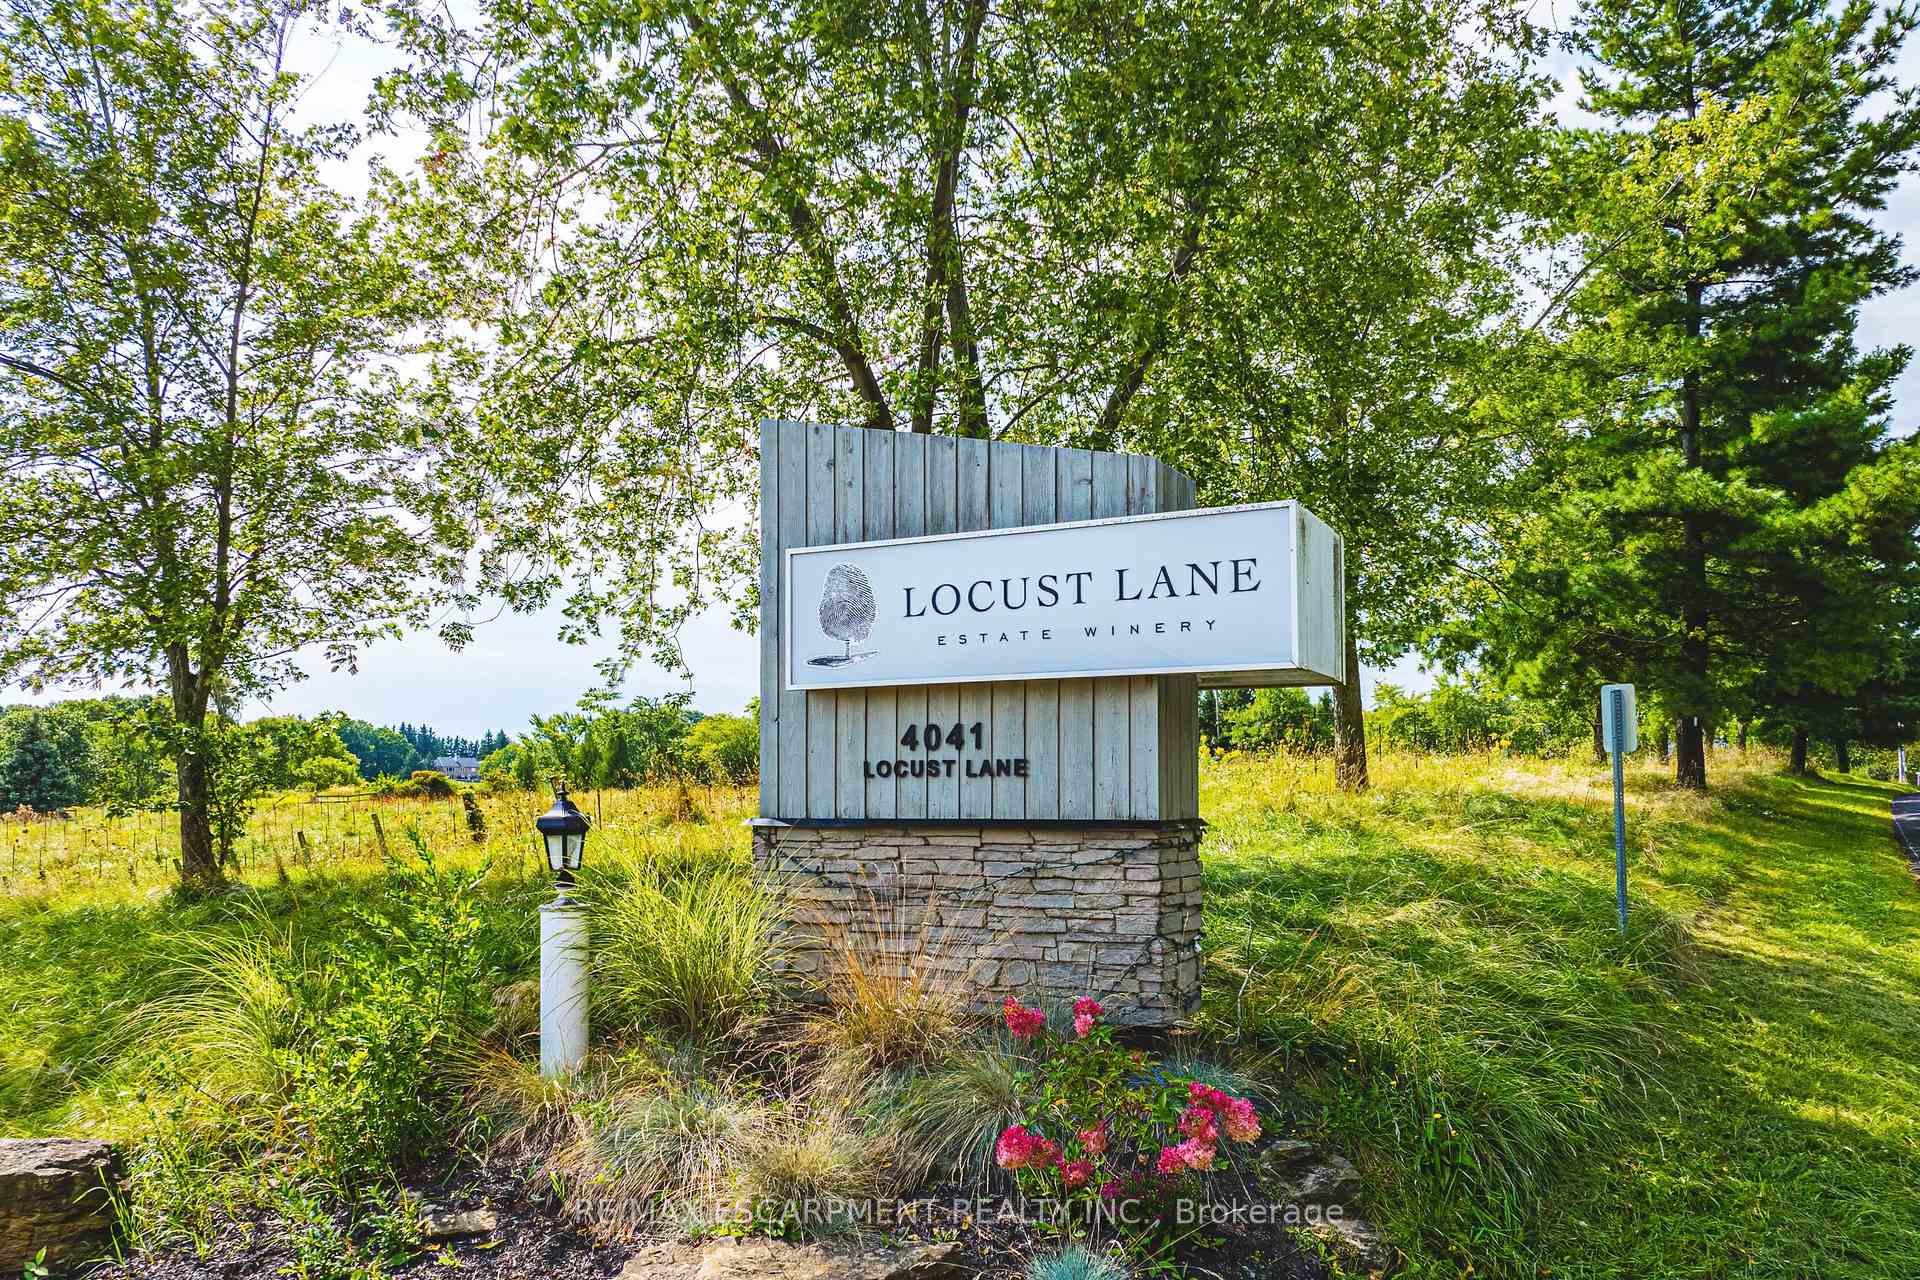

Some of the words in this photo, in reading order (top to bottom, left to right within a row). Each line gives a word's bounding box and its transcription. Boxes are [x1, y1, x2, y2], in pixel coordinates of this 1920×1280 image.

[903, 571, 1093, 618] LOCUST
[1114, 557, 1262, 602] LANE
[937, 629, 1052, 646] ESTATE
[1084, 618, 1216, 638] WINERY
[901, 721, 983, 752] 4041
[863, 760, 956, 779] LOCUST
[965, 758, 1030, 778] LANE
